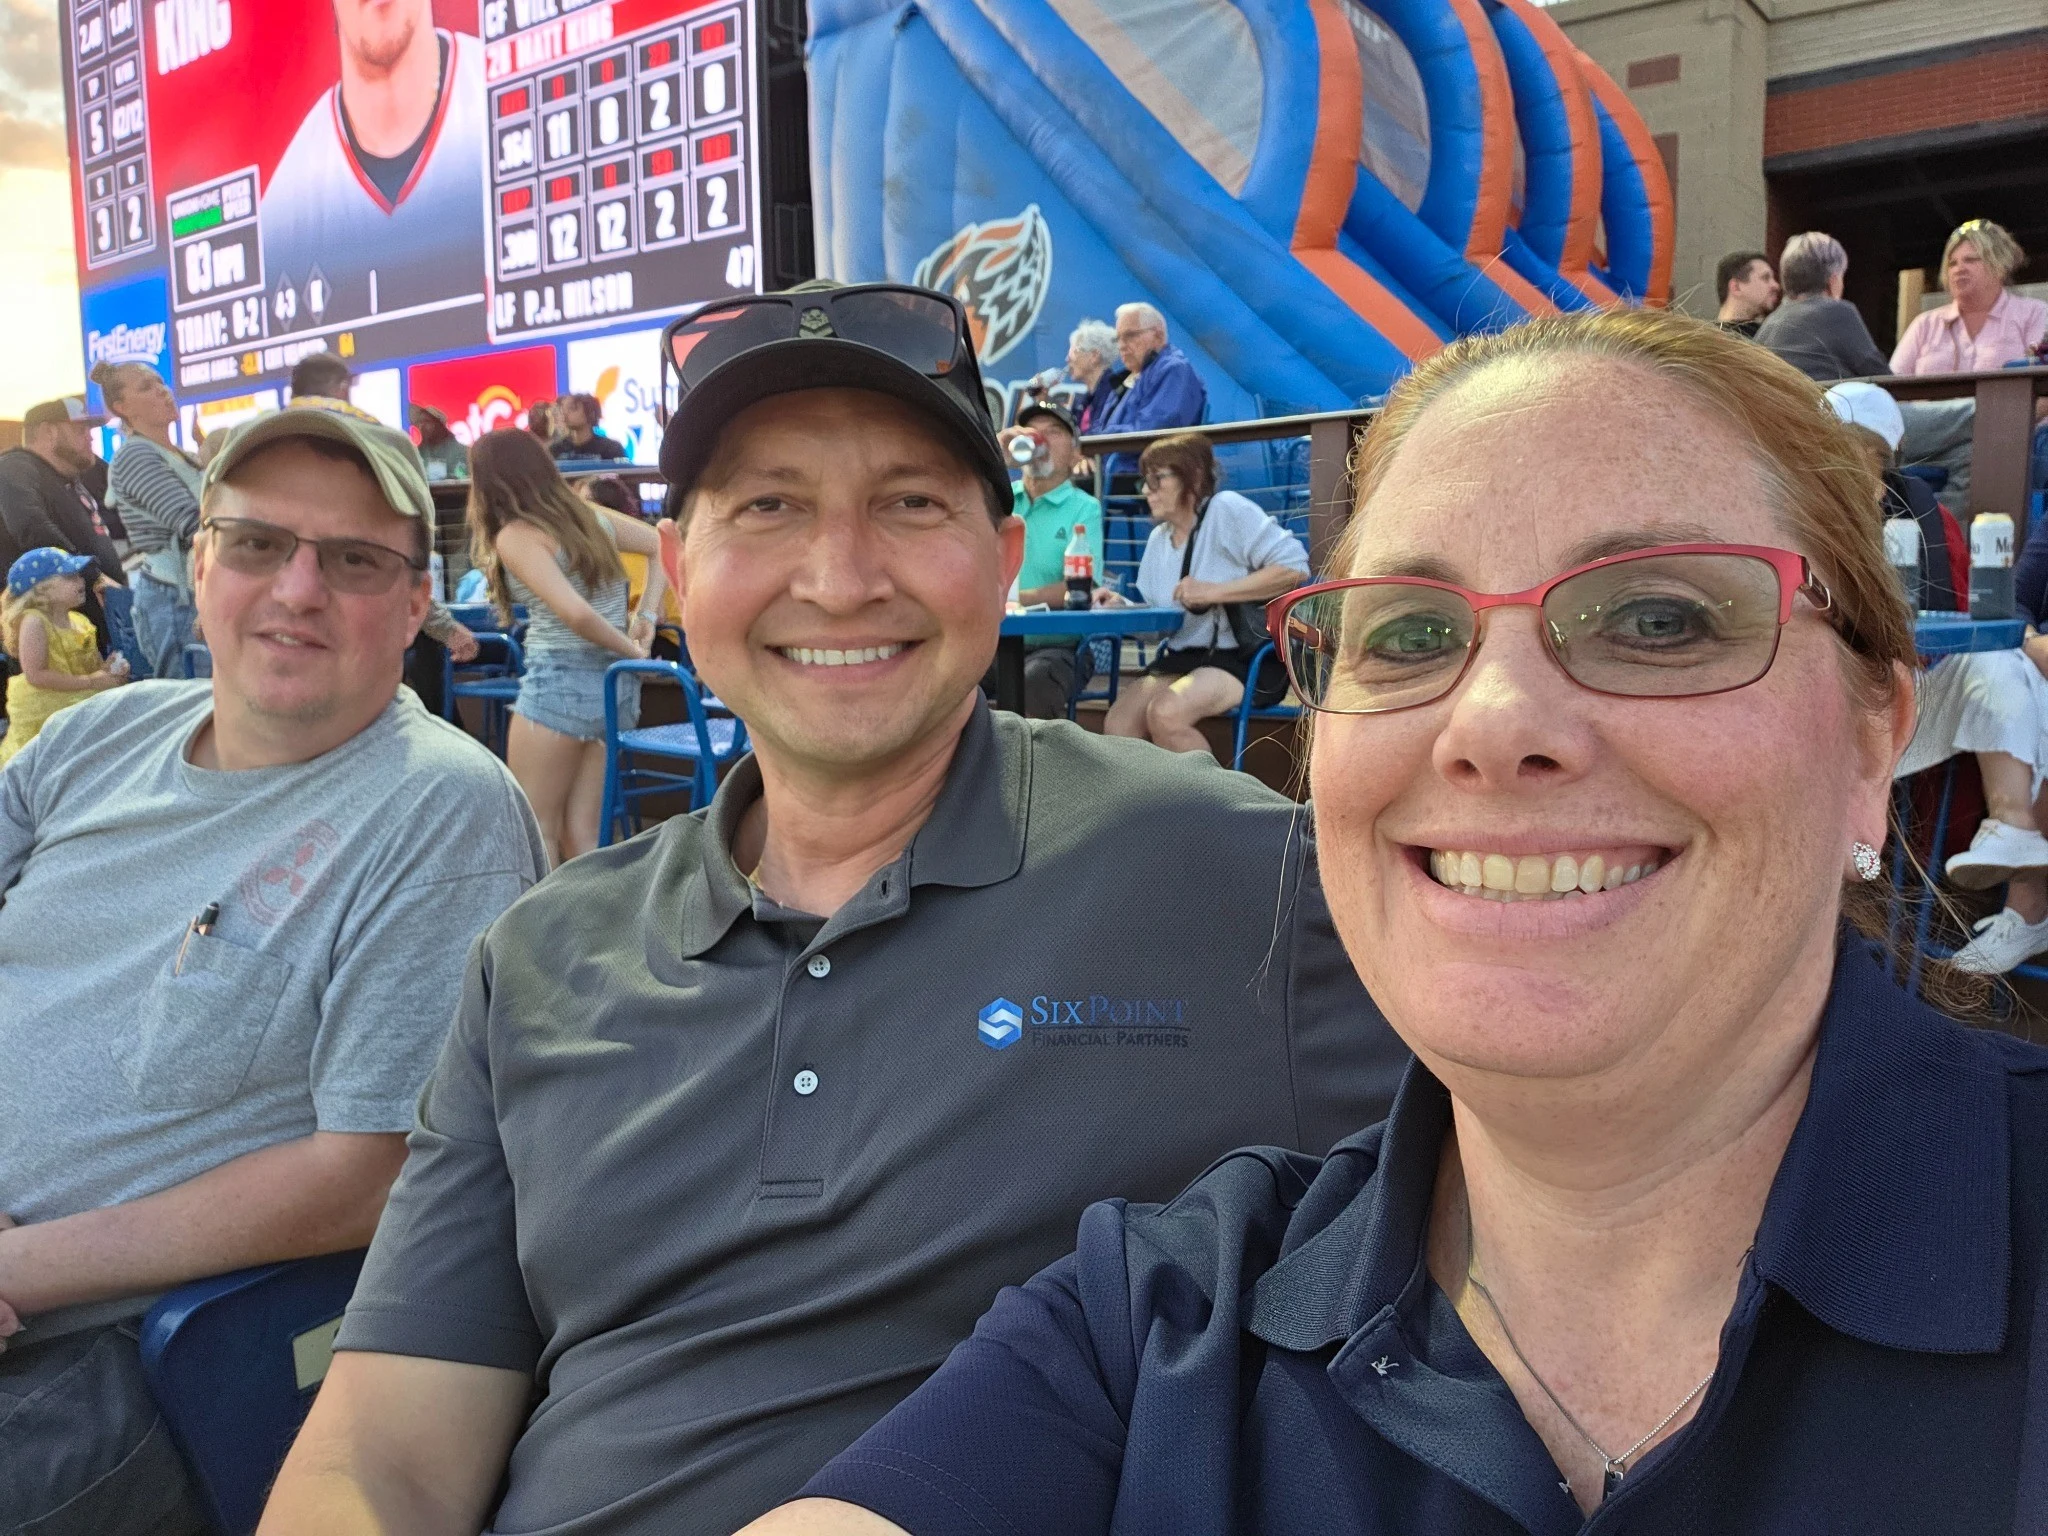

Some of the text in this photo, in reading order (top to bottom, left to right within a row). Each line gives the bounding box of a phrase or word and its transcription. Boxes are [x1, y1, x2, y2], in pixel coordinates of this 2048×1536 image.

[155, 0, 232, 75] KING
[649, 80, 671, 131] 2
[596, 201, 628, 252] 12
[655, 189, 676, 239] 2
[706, 176, 728, 228] 2
[549, 213, 579, 262] 12
